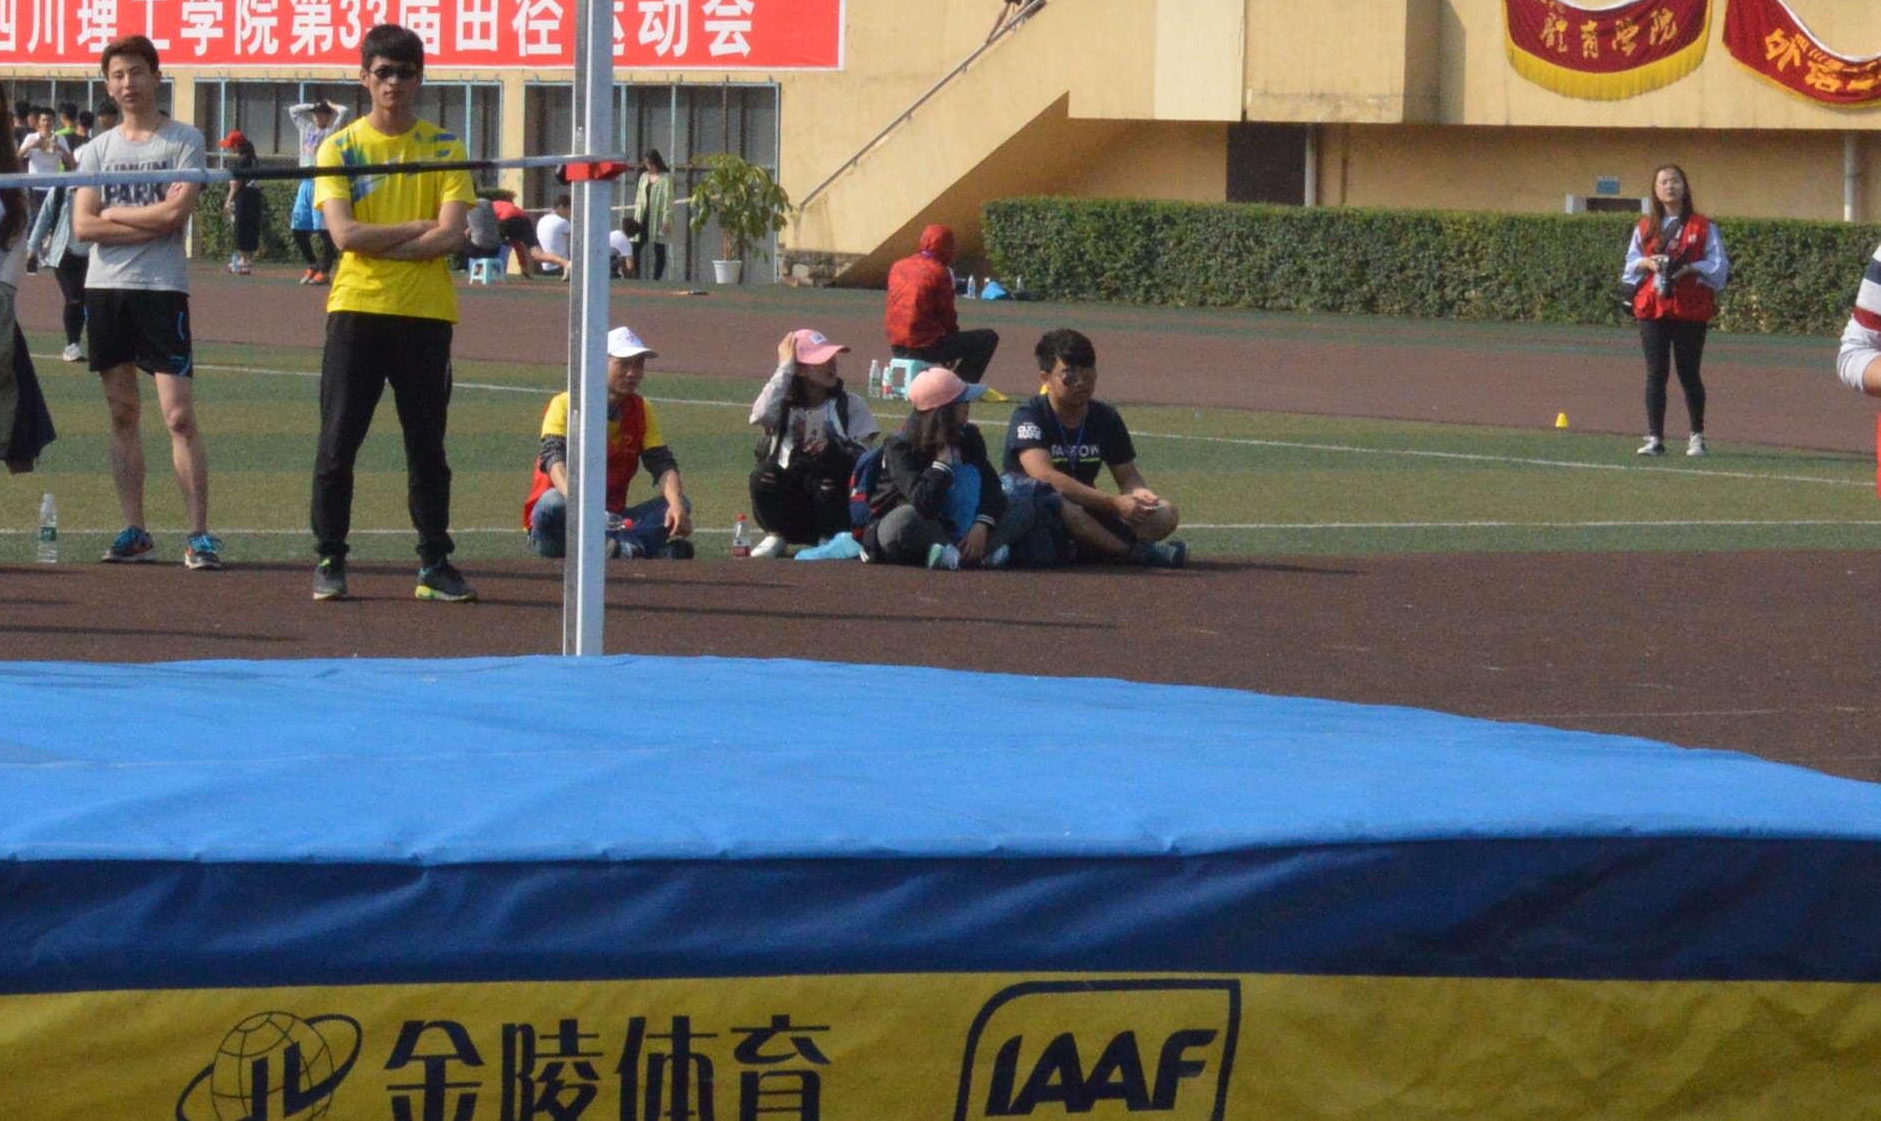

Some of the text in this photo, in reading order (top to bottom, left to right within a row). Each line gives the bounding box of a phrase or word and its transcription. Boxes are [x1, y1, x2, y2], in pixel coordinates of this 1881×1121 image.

[383, 1014, 831, 1121] 金陵体育
[984, 1029, 1218, 1117] IAAF
